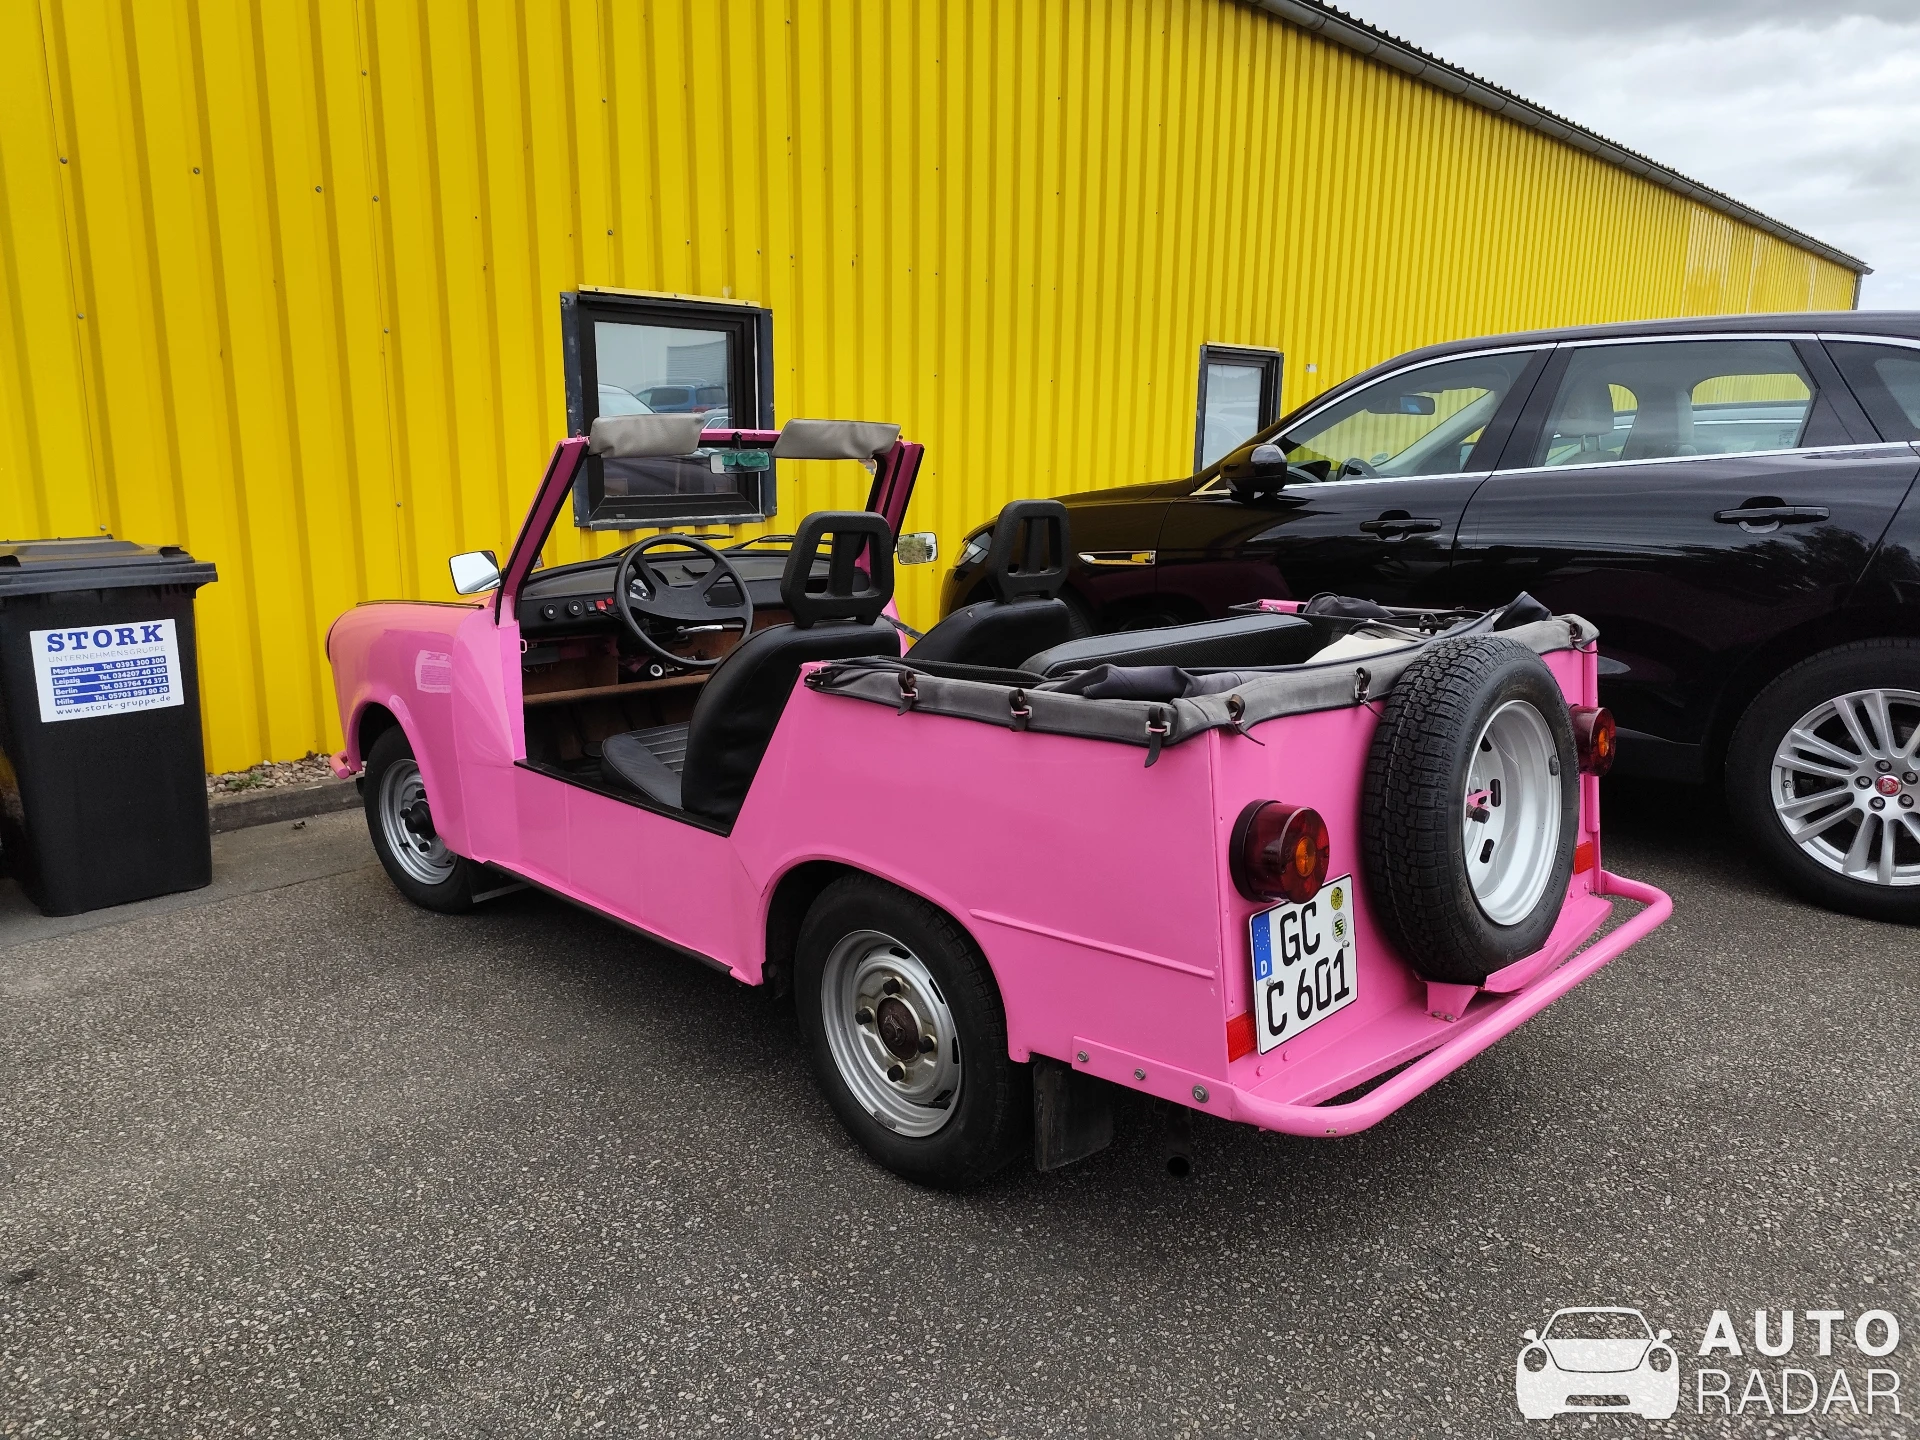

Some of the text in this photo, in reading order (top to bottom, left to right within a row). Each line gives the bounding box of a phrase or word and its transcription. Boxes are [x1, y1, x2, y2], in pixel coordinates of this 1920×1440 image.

[47, 624, 163, 653] STORK
[48, 645, 166, 663] UNTERNEHMENSGRUPPE
[52, 666, 95, 676] Magdeburg
[116, 660, 135, 668] 0391
[53, 676, 81, 686] Leipzig
[98, 673, 111, 681] Tel.
[152, 666, 166, 674] 300
[55, 687, 78, 695] Berlin
[153, 676, 167, 684] 371
[56, 698, 75, 706] Hille
[56, 695, 171, 715] www.stork-gruppe.de
[1280, 901, 1321, 967] GC
[1260, 960, 1268, 976] D
[1266, 948, 1350, 1036] C 601
